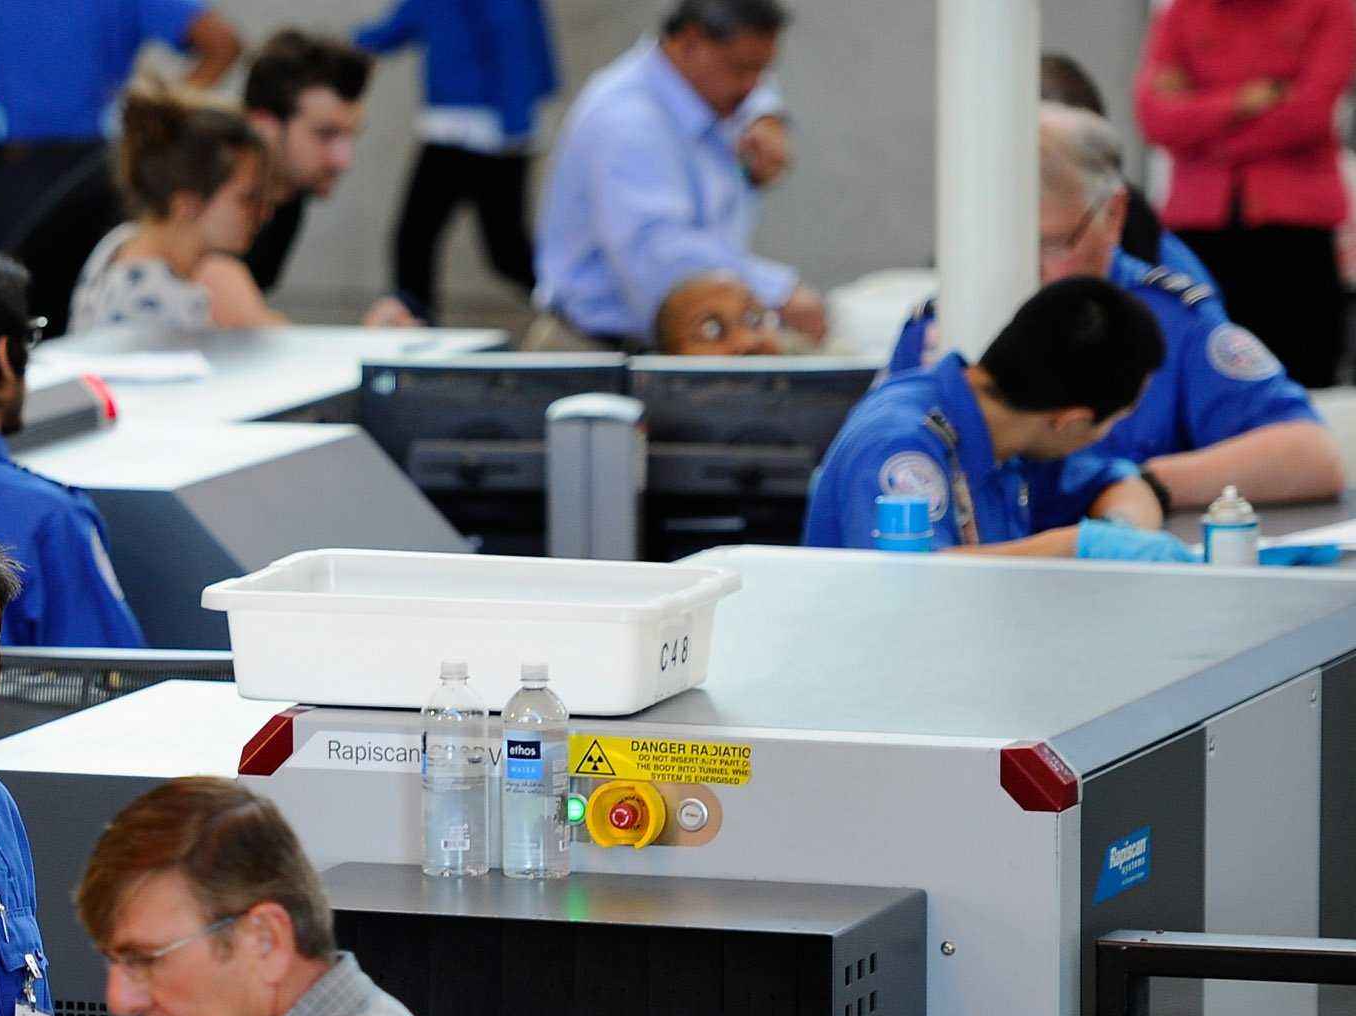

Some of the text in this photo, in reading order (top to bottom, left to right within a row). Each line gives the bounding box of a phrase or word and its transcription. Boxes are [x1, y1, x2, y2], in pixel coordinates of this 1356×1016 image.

[327, 740, 421, 765] Rapiscan
[509, 744, 536, 756] ethos
[631, 740, 686, 754] DANGER
[652, 754, 670, 762] NOT
[671, 756, 699, 765] INSERT
[719, 759, 740, 768] PART
[636, 763, 651, 771] THE
[653, 764, 676, 772] BODY
[678, 765, 697, 773] INTO
[699, 766, 729, 775] TUNNEL
[651, 772, 682, 781] SYSTEM
[694, 776, 740, 785] ENERGISED
